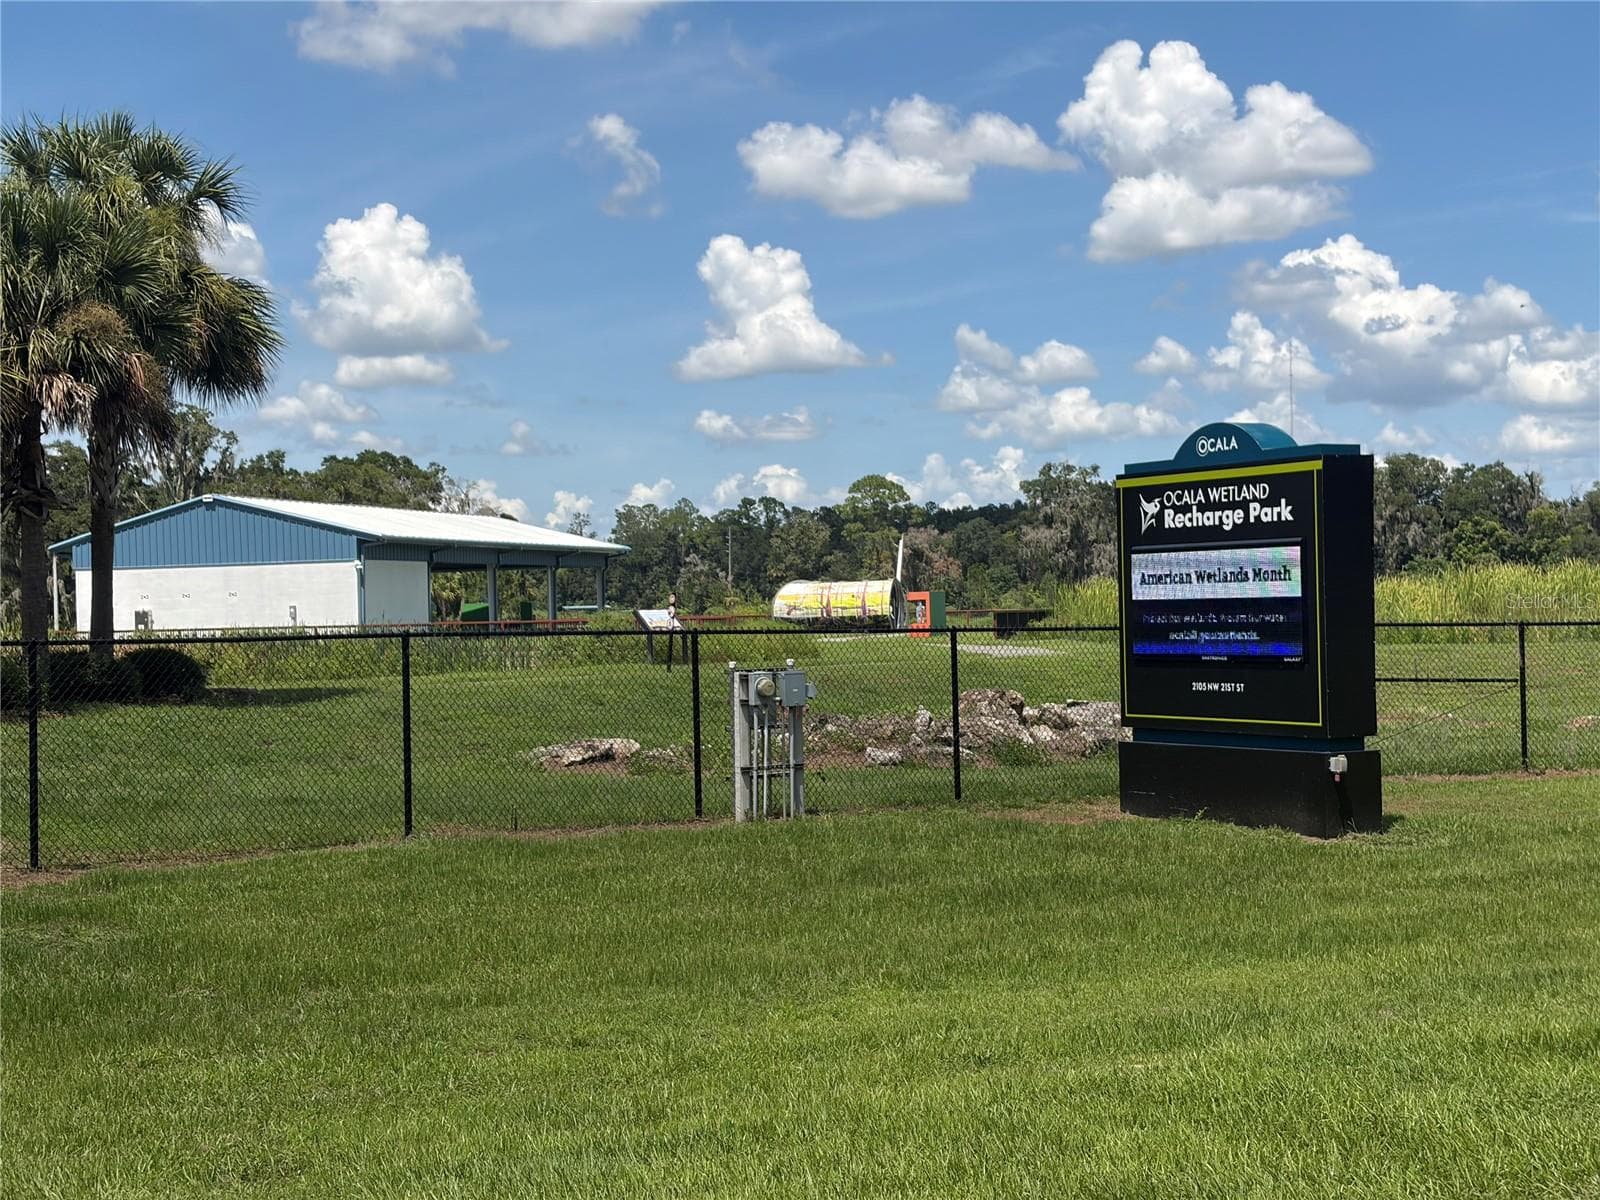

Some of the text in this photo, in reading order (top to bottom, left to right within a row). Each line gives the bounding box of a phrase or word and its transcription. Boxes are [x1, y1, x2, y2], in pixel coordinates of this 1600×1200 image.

[1196, 436, 1238, 457] OCALA
[1163, 483, 1270, 506] OCALA WETLAND
[1164, 498, 1294, 531] Recharge Park
[1139, 565, 1292, 586] American Wetlands Month
[1191, 681, 1245, 693] 2105 NW 21ST ST
